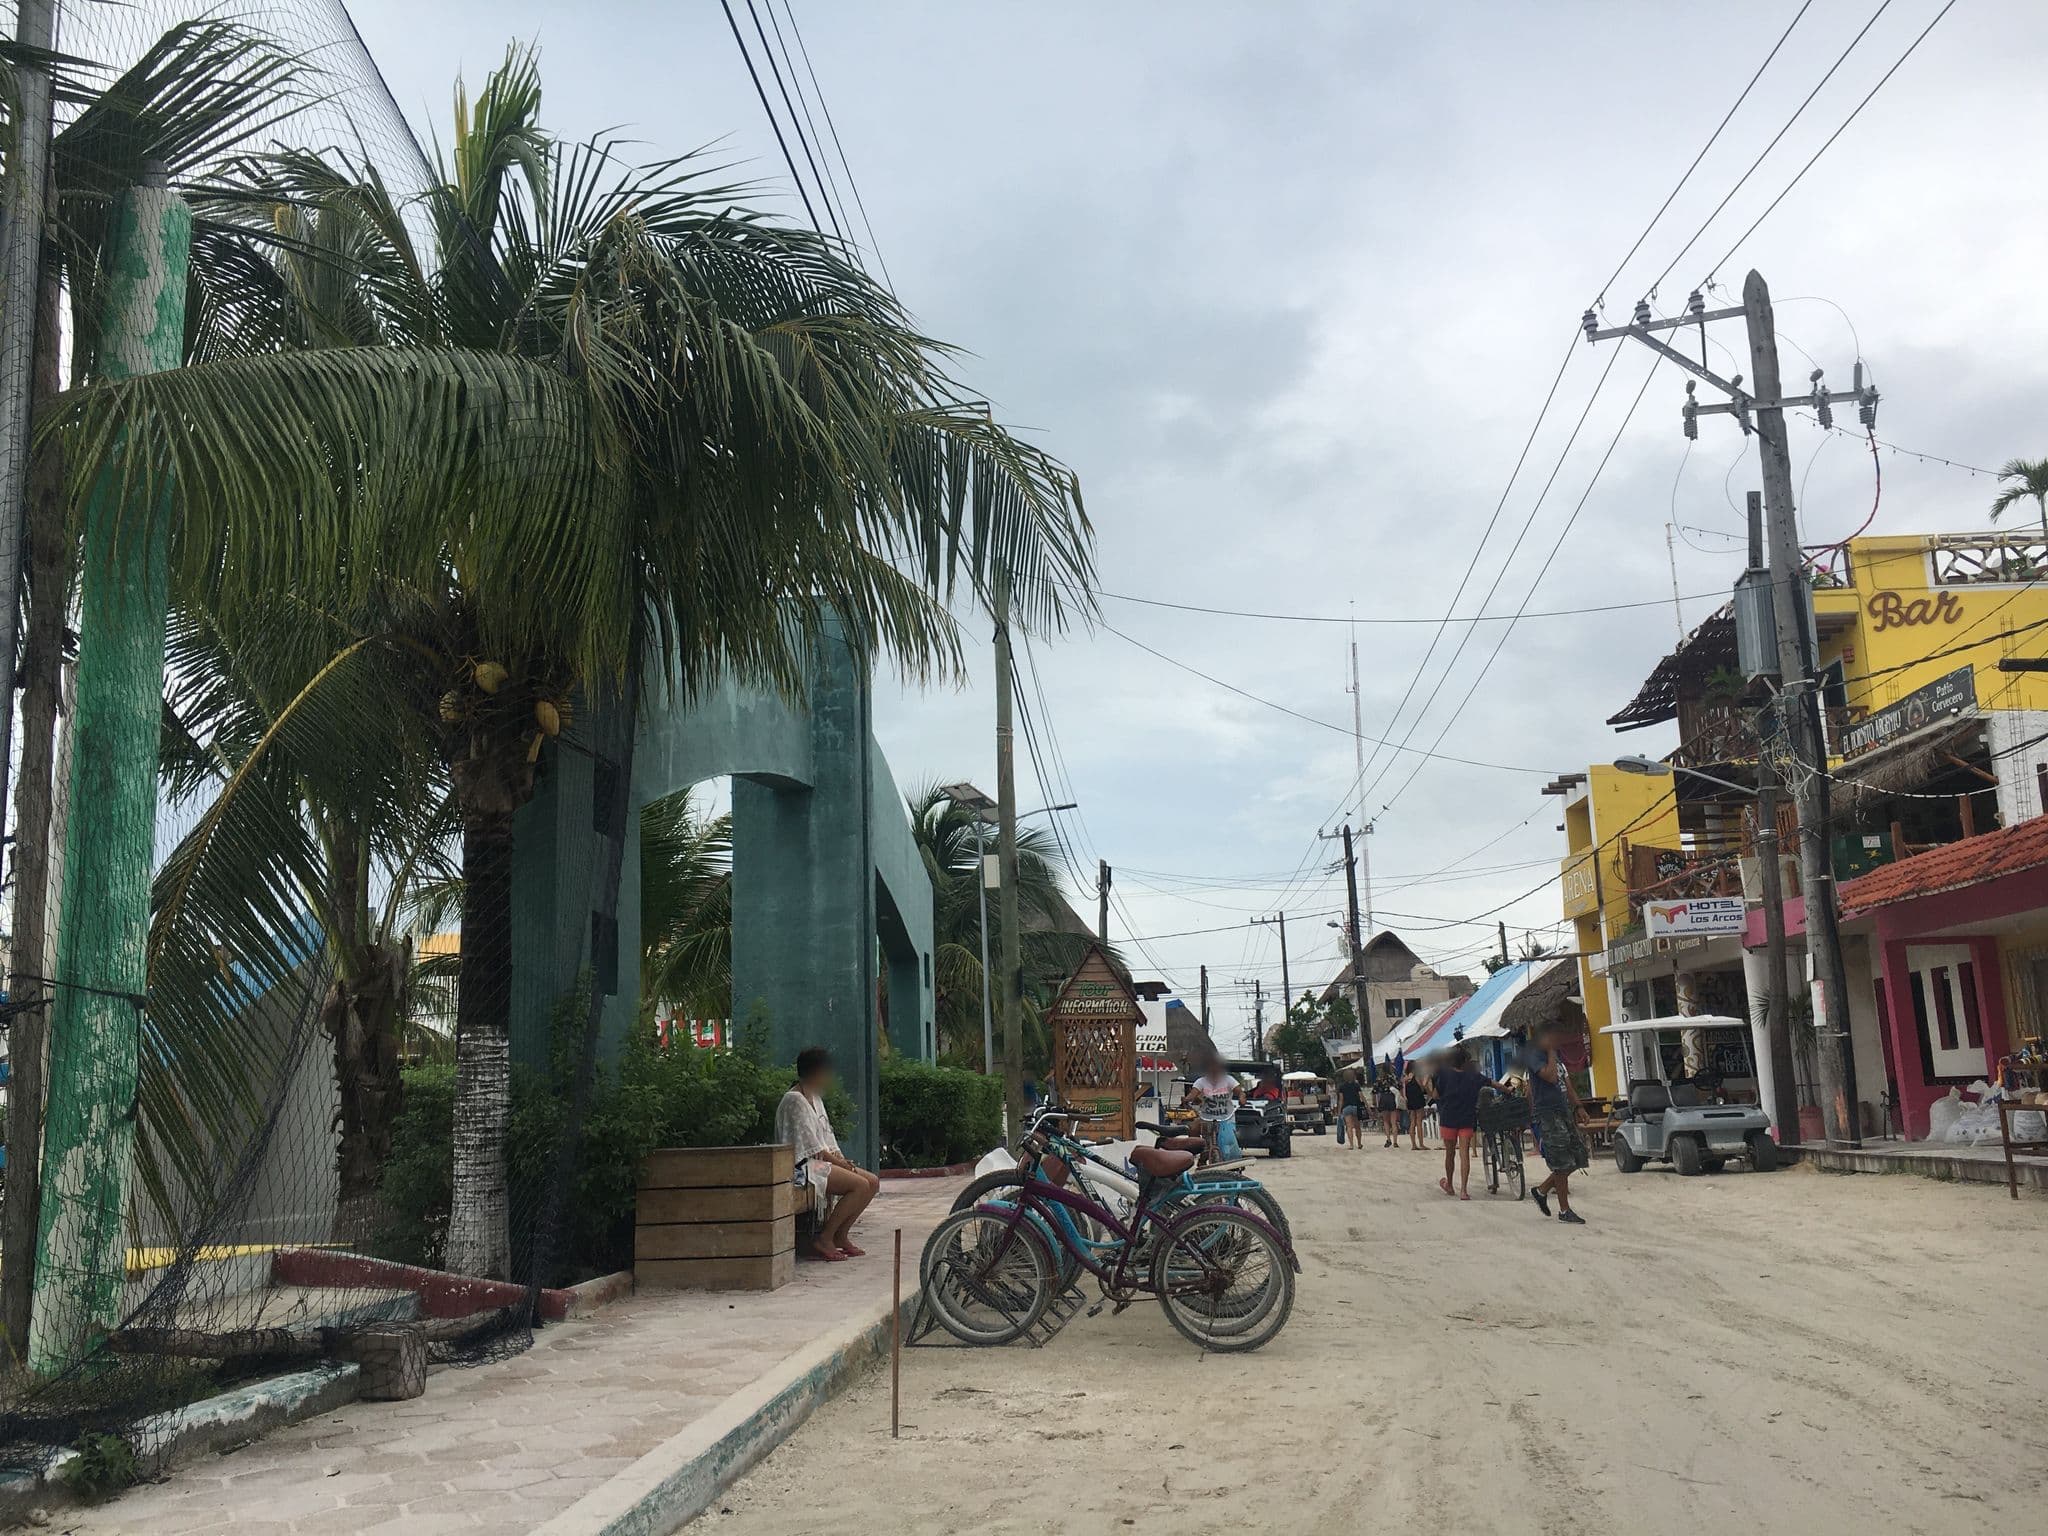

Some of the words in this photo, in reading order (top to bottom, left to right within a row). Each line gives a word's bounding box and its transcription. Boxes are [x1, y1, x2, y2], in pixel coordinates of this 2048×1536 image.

[1868, 591, 1964, 632] Bar
[1935, 681, 1954, 698] Patio
[1931, 692, 1964, 713] Cervecero
[1689, 900, 1742, 910] HOTEL
[1690, 915, 1709, 923] Los
[1712, 914, 1743, 922] Arcos
[1080, 982, 1114, 996] Tour
[1060, 999, 1129, 1014] INFORMATION
